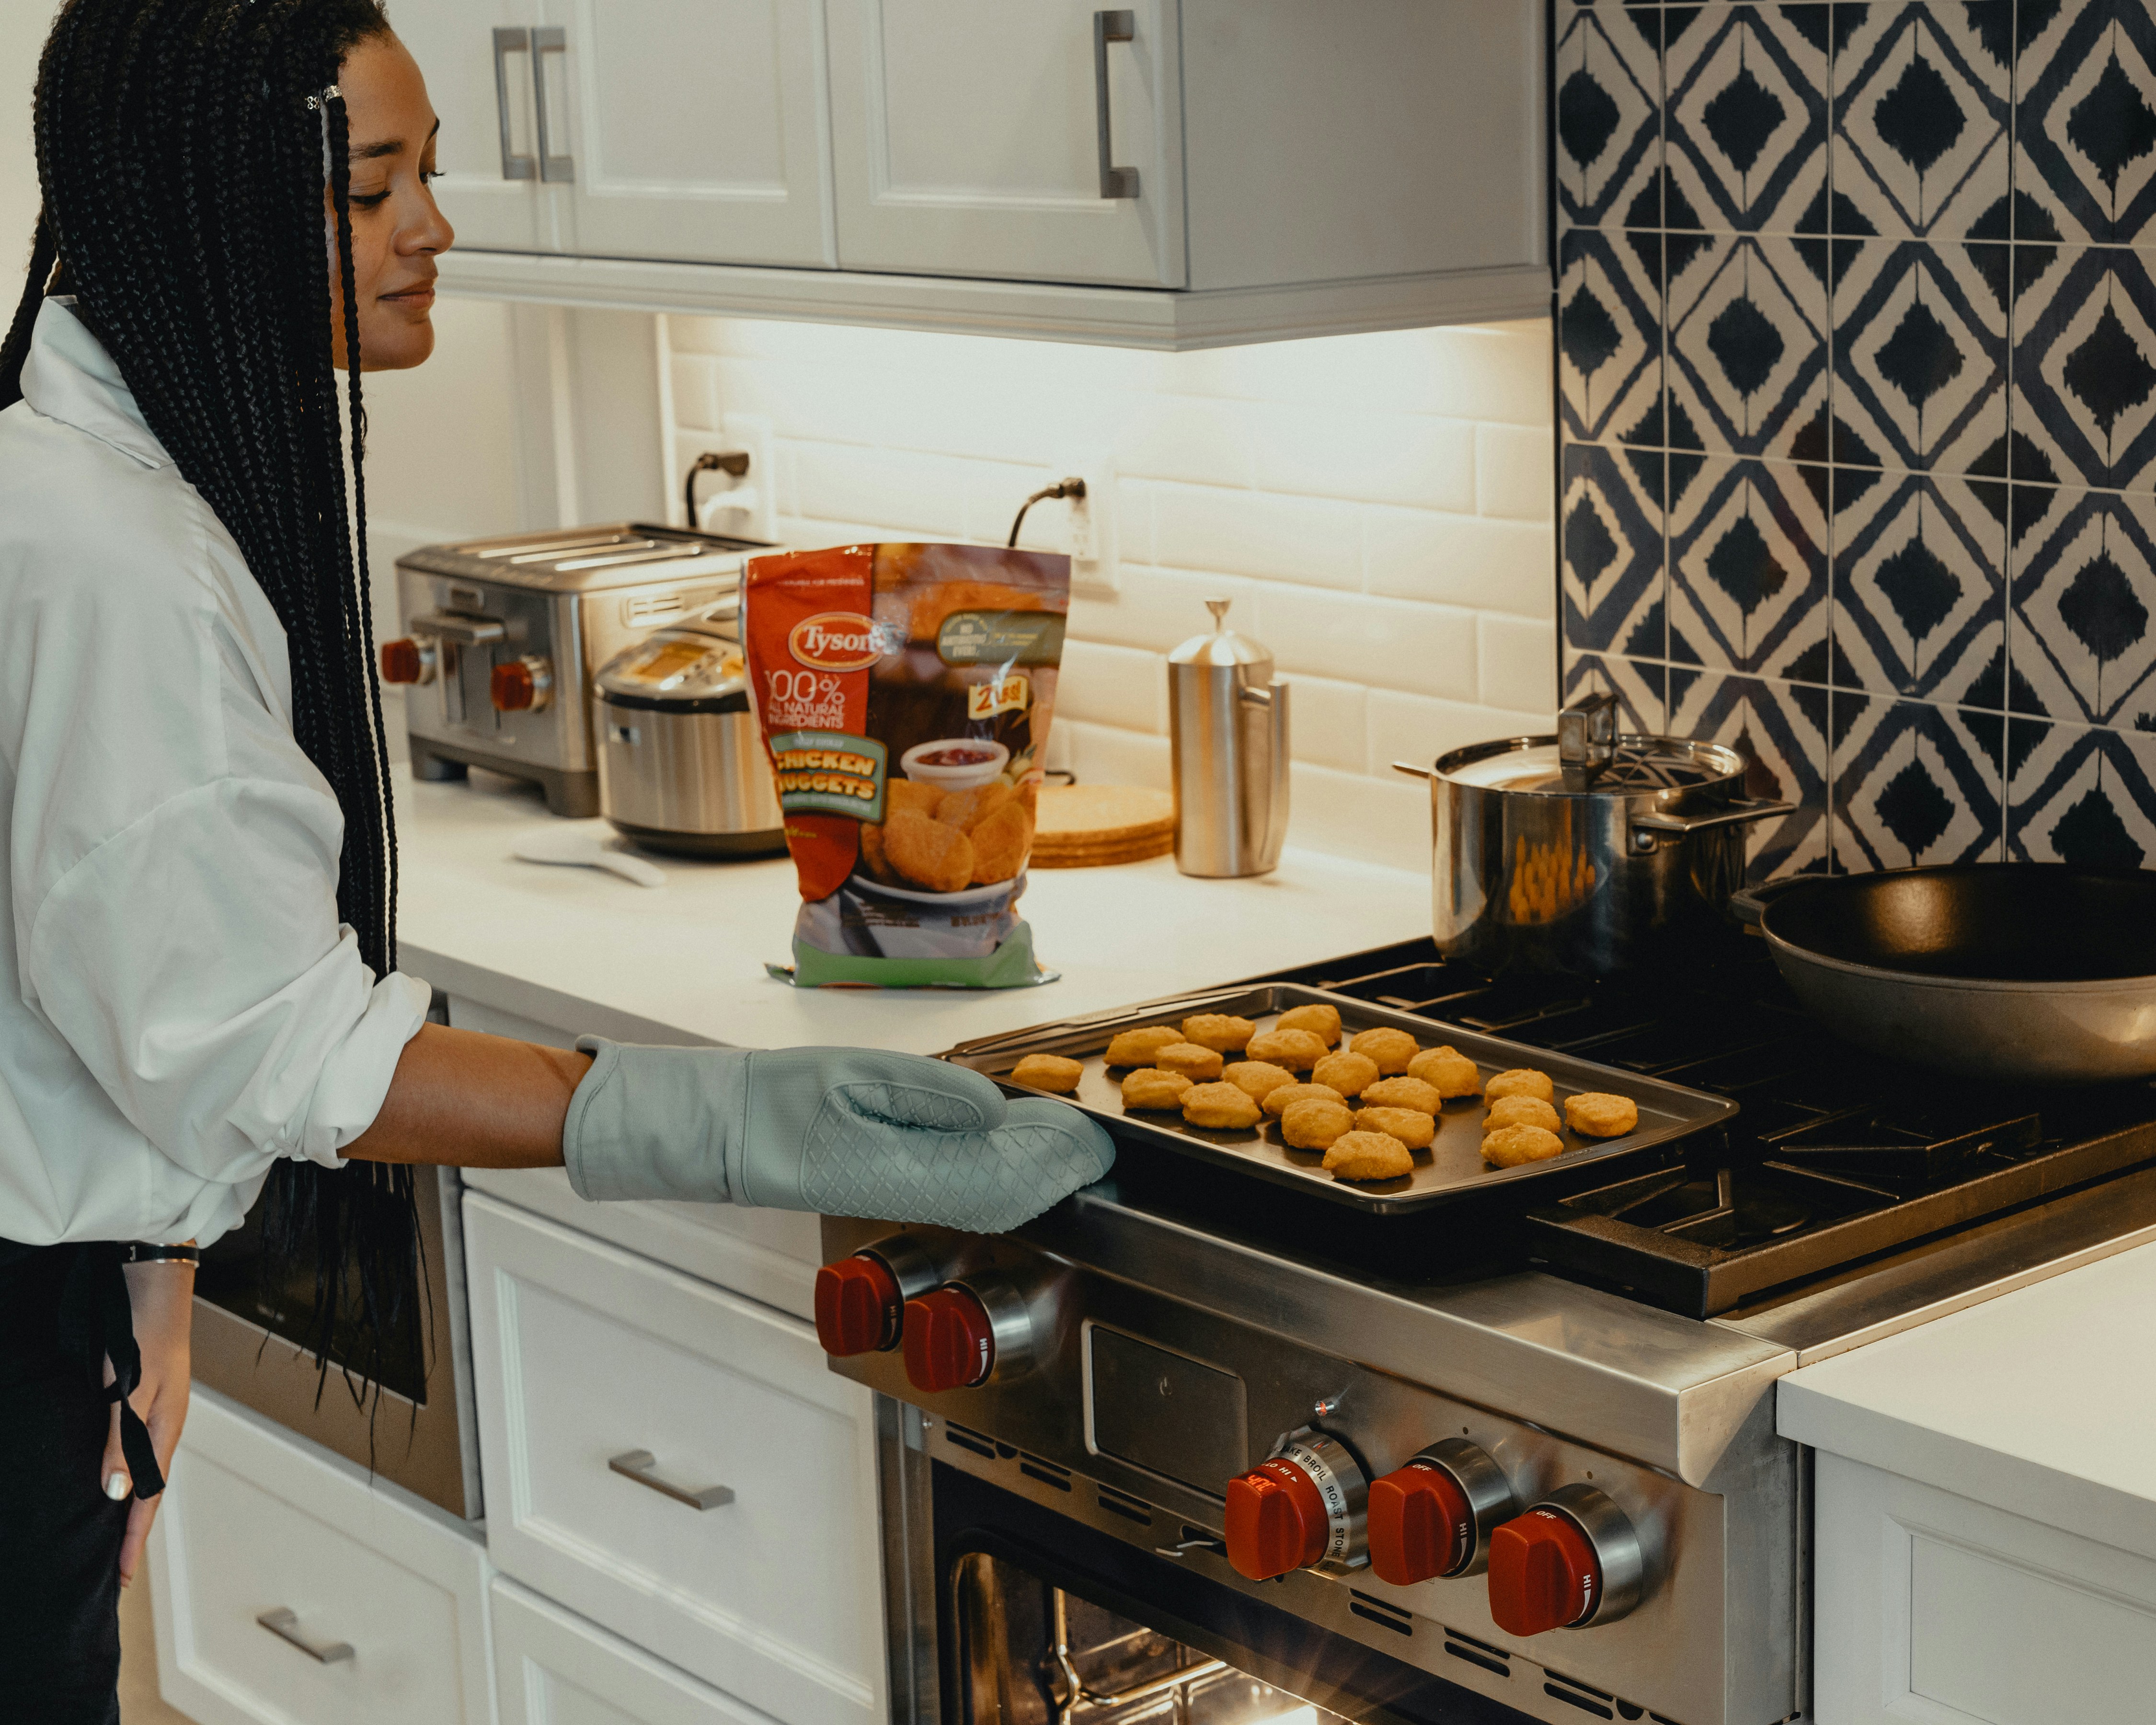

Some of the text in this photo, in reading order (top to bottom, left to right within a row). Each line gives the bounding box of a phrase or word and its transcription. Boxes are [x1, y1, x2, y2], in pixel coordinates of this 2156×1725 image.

[803, 624, 876, 657] Tyson
[1278, 1467, 1292, 1475] HI
[1303, 1455, 1326, 1481] BROIL
[1325, 1485, 1343, 1520] ROAST
[1536, 1510, 1557, 1520] OFF
[1459, 1522, 1467, 1536] HI
[1331, 1527, 1344, 1557] STONE
[1583, 1574, 1592, 1588] HI
